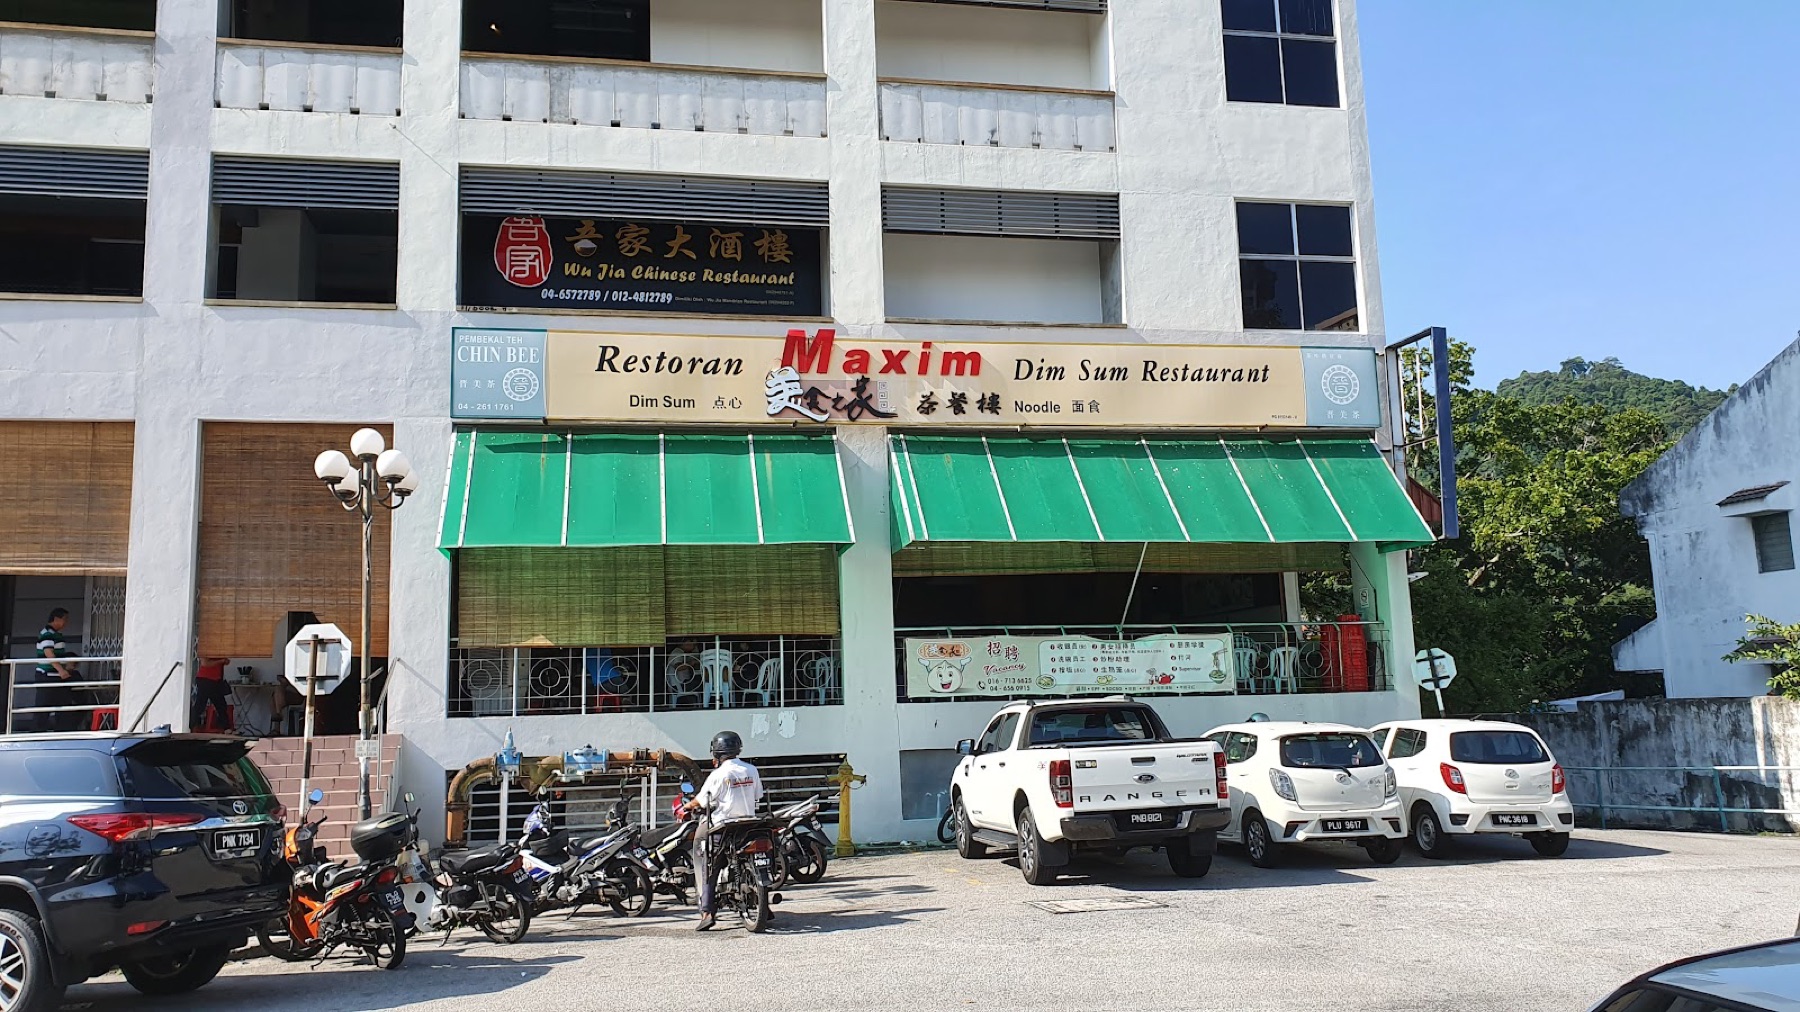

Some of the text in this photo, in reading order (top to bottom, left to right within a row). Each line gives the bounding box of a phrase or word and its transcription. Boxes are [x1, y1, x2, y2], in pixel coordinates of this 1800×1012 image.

[564, 263, 795, 286] Wu Jia Chinese Restaurant
[541, 289, 601, 302] 04-6572789
[612, 291, 673, 304] 012-4812789
[459, 334, 523, 344] PEMBEKAL TEH
[457, 345, 540, 364] CHIN BEE
[594, 344, 744, 376] Restoran
[781, 328, 982, 377] Maxim
[1014, 358, 1270, 383] Dim Sum Restaurant
[629, 394, 696, 409] Dim Sum
[1014, 400, 1061, 414] Noodle
[1072, 400, 1101, 413] 面食
[987, 640, 1020, 661] 招聘
[983, 662, 1027, 676] Vacancy
[1079, 788, 1211, 803] RANGER
[1131, 813, 1162, 823] PNB 8121
[1327, 820, 1361, 830] PLU 9617
[223, 833, 253, 848] PNK 7134
